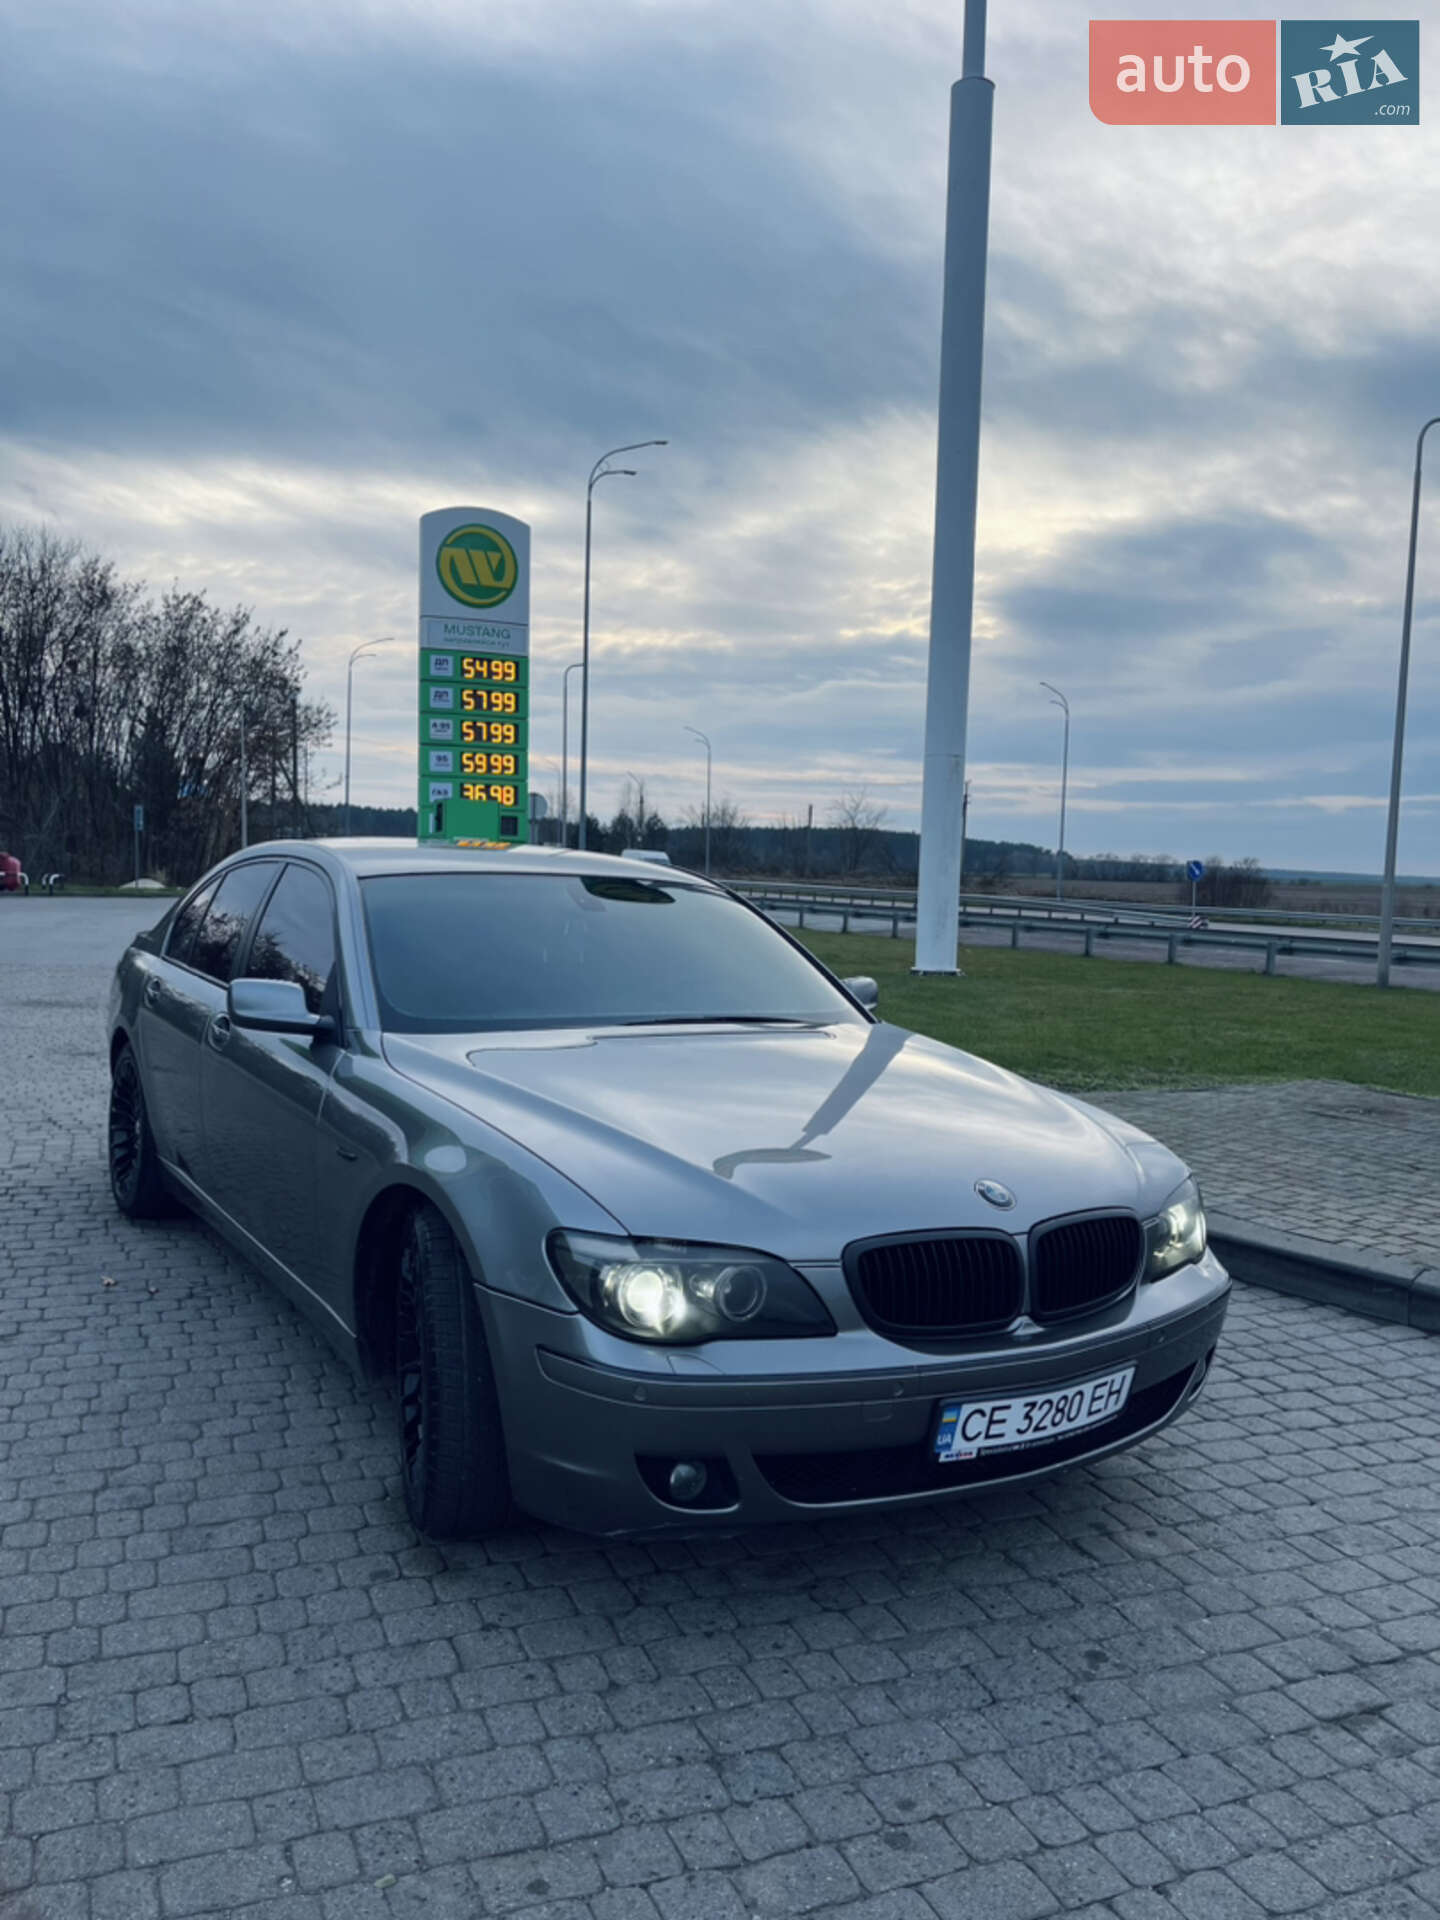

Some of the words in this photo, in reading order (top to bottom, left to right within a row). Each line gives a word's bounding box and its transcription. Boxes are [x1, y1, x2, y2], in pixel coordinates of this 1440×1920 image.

[443, 623, 511, 640] MUSTANG
[961, 1405, 1012, 1442] CE
[1016, 1390, 1085, 1435] 3280
[1087, 1375, 1127, 1417] EH
